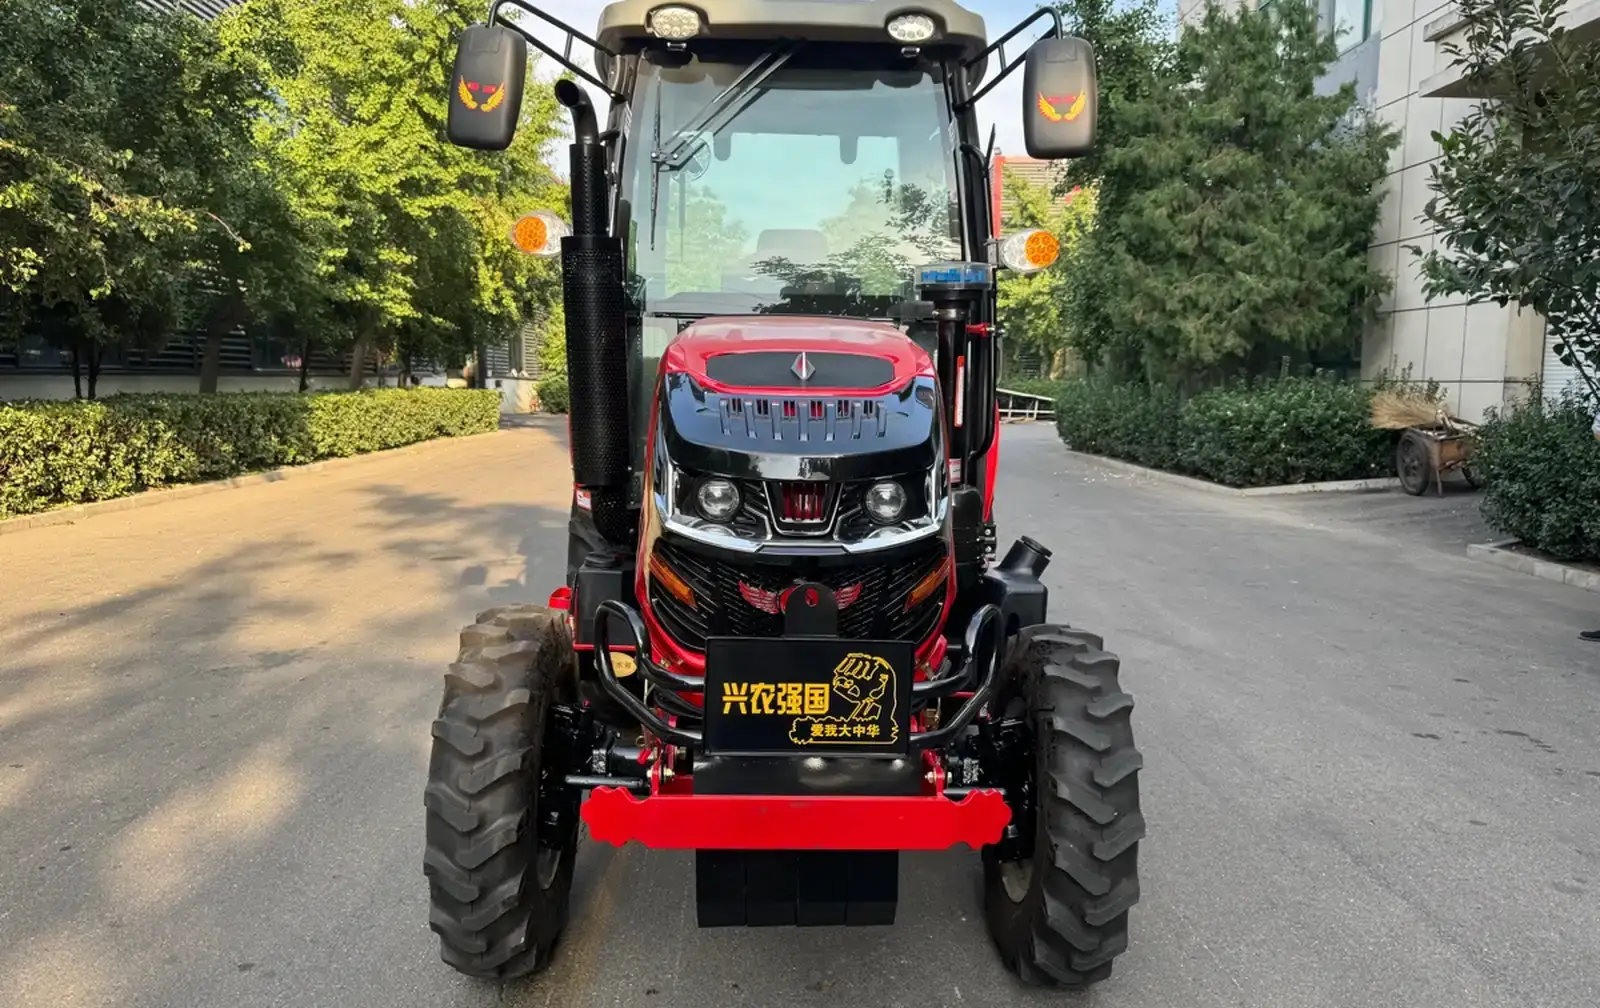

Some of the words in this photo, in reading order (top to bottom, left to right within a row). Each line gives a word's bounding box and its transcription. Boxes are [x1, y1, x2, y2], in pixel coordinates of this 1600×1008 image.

[722, 682, 830, 715] 兴农强国
[810, 723, 880, 738] 爱我大中华
